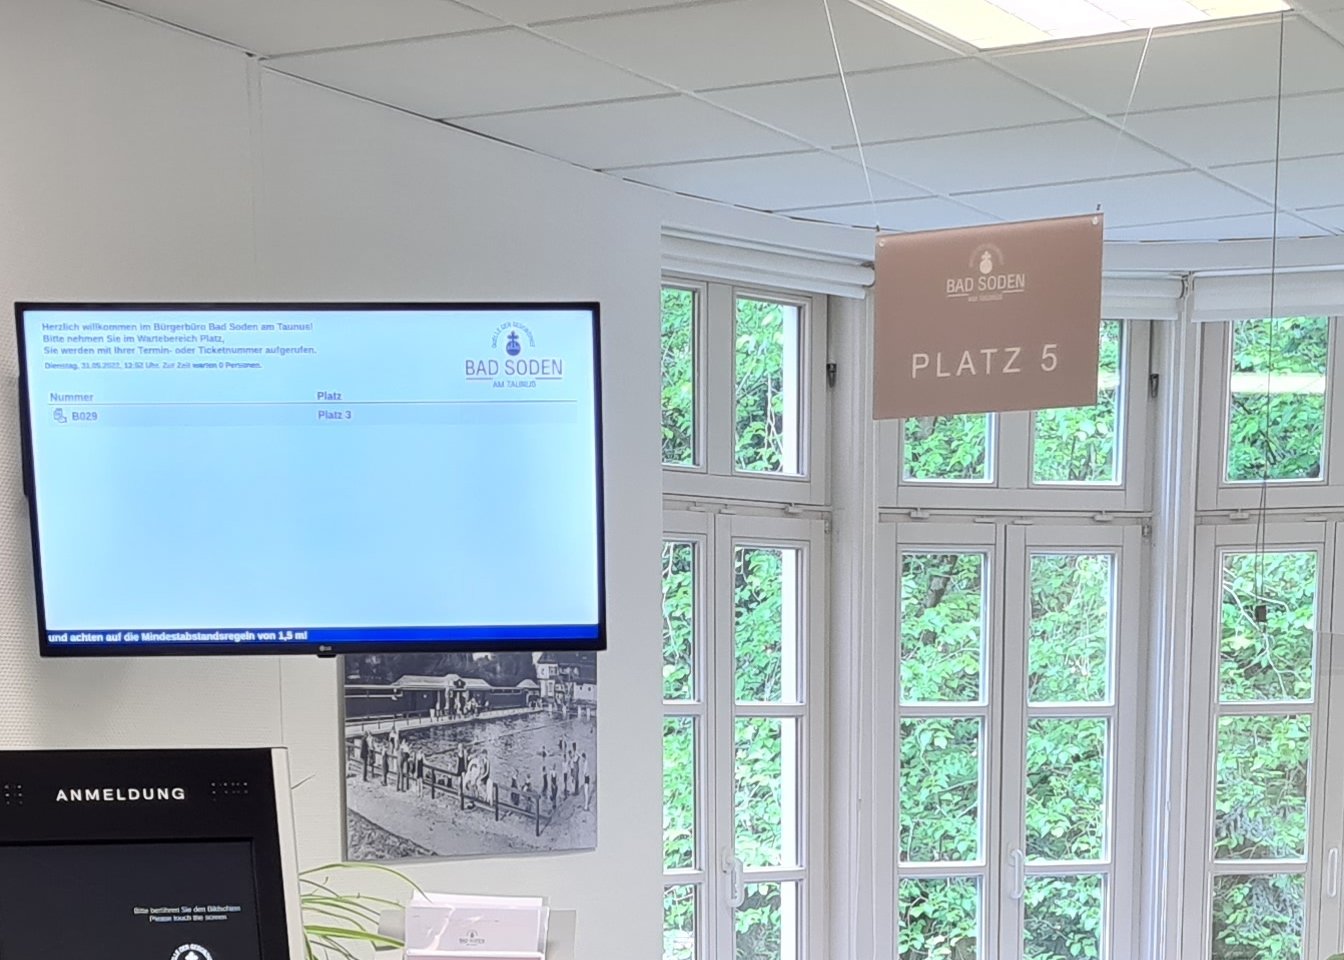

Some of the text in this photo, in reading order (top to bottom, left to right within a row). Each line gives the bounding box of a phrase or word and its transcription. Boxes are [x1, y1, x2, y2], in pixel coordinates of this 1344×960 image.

[947, 273, 1025, 294] BAD SODEN
[42, 323, 79, 331] Herzlich
[82, 323, 137, 331] willkommen
[140, 323, 151, 331] im
[154, 323, 206, 333] Bürgerbüro
[208, 323, 227, 331] Bad
[229, 323, 258, 331] Soden
[277, 323, 313, 331] Taunus!
[43, 335, 225, 344] Bitte nehmen Sie im Wartebereich Platz,
[44, 346, 317, 356] Sie werden mit Ihrer Termin- oder Ticketnummer aufgerufen.
[912, 343, 1057, 379] PLATZ 5
[465, 358, 563, 376] BAD SODEN
[50, 392, 93, 402] Nummer
[317, 391, 342, 401] Platz
[318, 410, 352, 420] Platz 3
[48, 633, 68, 643] und
[70, 632, 103, 643] achten
[105, 632, 122, 643] auf
[124, 632, 140, 642] die
[141, 630, 255, 643] Mindestabstandsregeln
[258, 632, 277, 641] von
[278, 630, 293, 641] 1,5
[56, 787, 185, 802] ANMELDUNG
[180, 905, 192, 913] Sie
[193, 905, 206, 913] den
